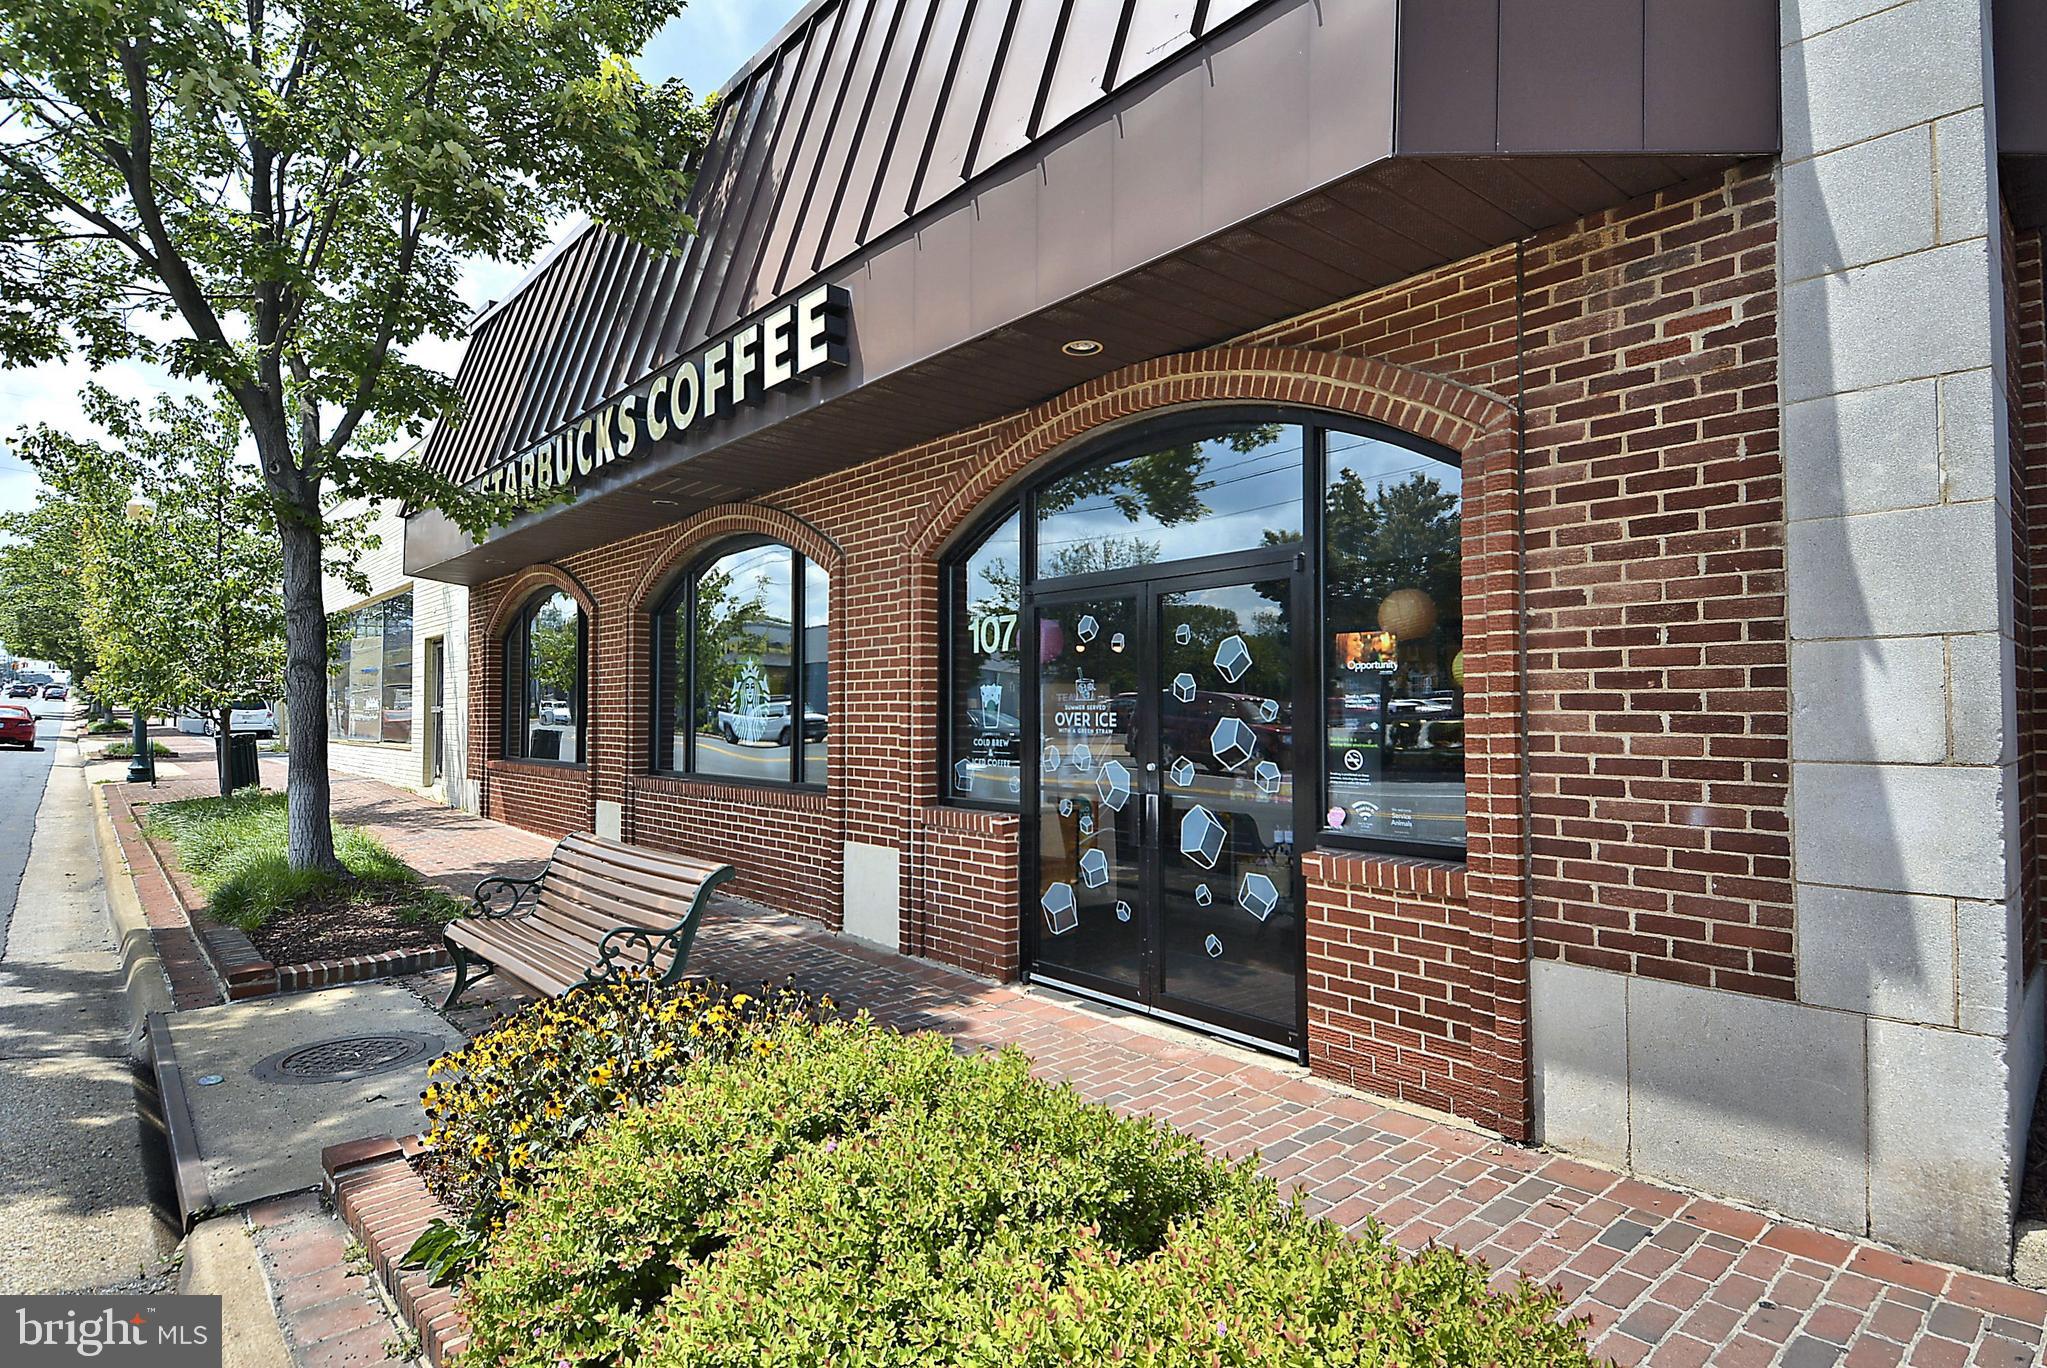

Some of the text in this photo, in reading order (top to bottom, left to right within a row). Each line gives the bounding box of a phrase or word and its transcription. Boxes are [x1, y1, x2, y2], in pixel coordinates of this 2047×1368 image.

[646, 282, 832, 441] COFFEE
[968, 614, 1017, 654] 107
[1346, 660, 1398, 673] Opportunity
[1055, 711, 1117, 727] OVER ICE
[973, 738, 1010, 747] COLD BREW
[987, 759, 1011, 767] COFFEE
[1391, 812, 1412, 820] Service
[1391, 819, 1413, 828] Animals
